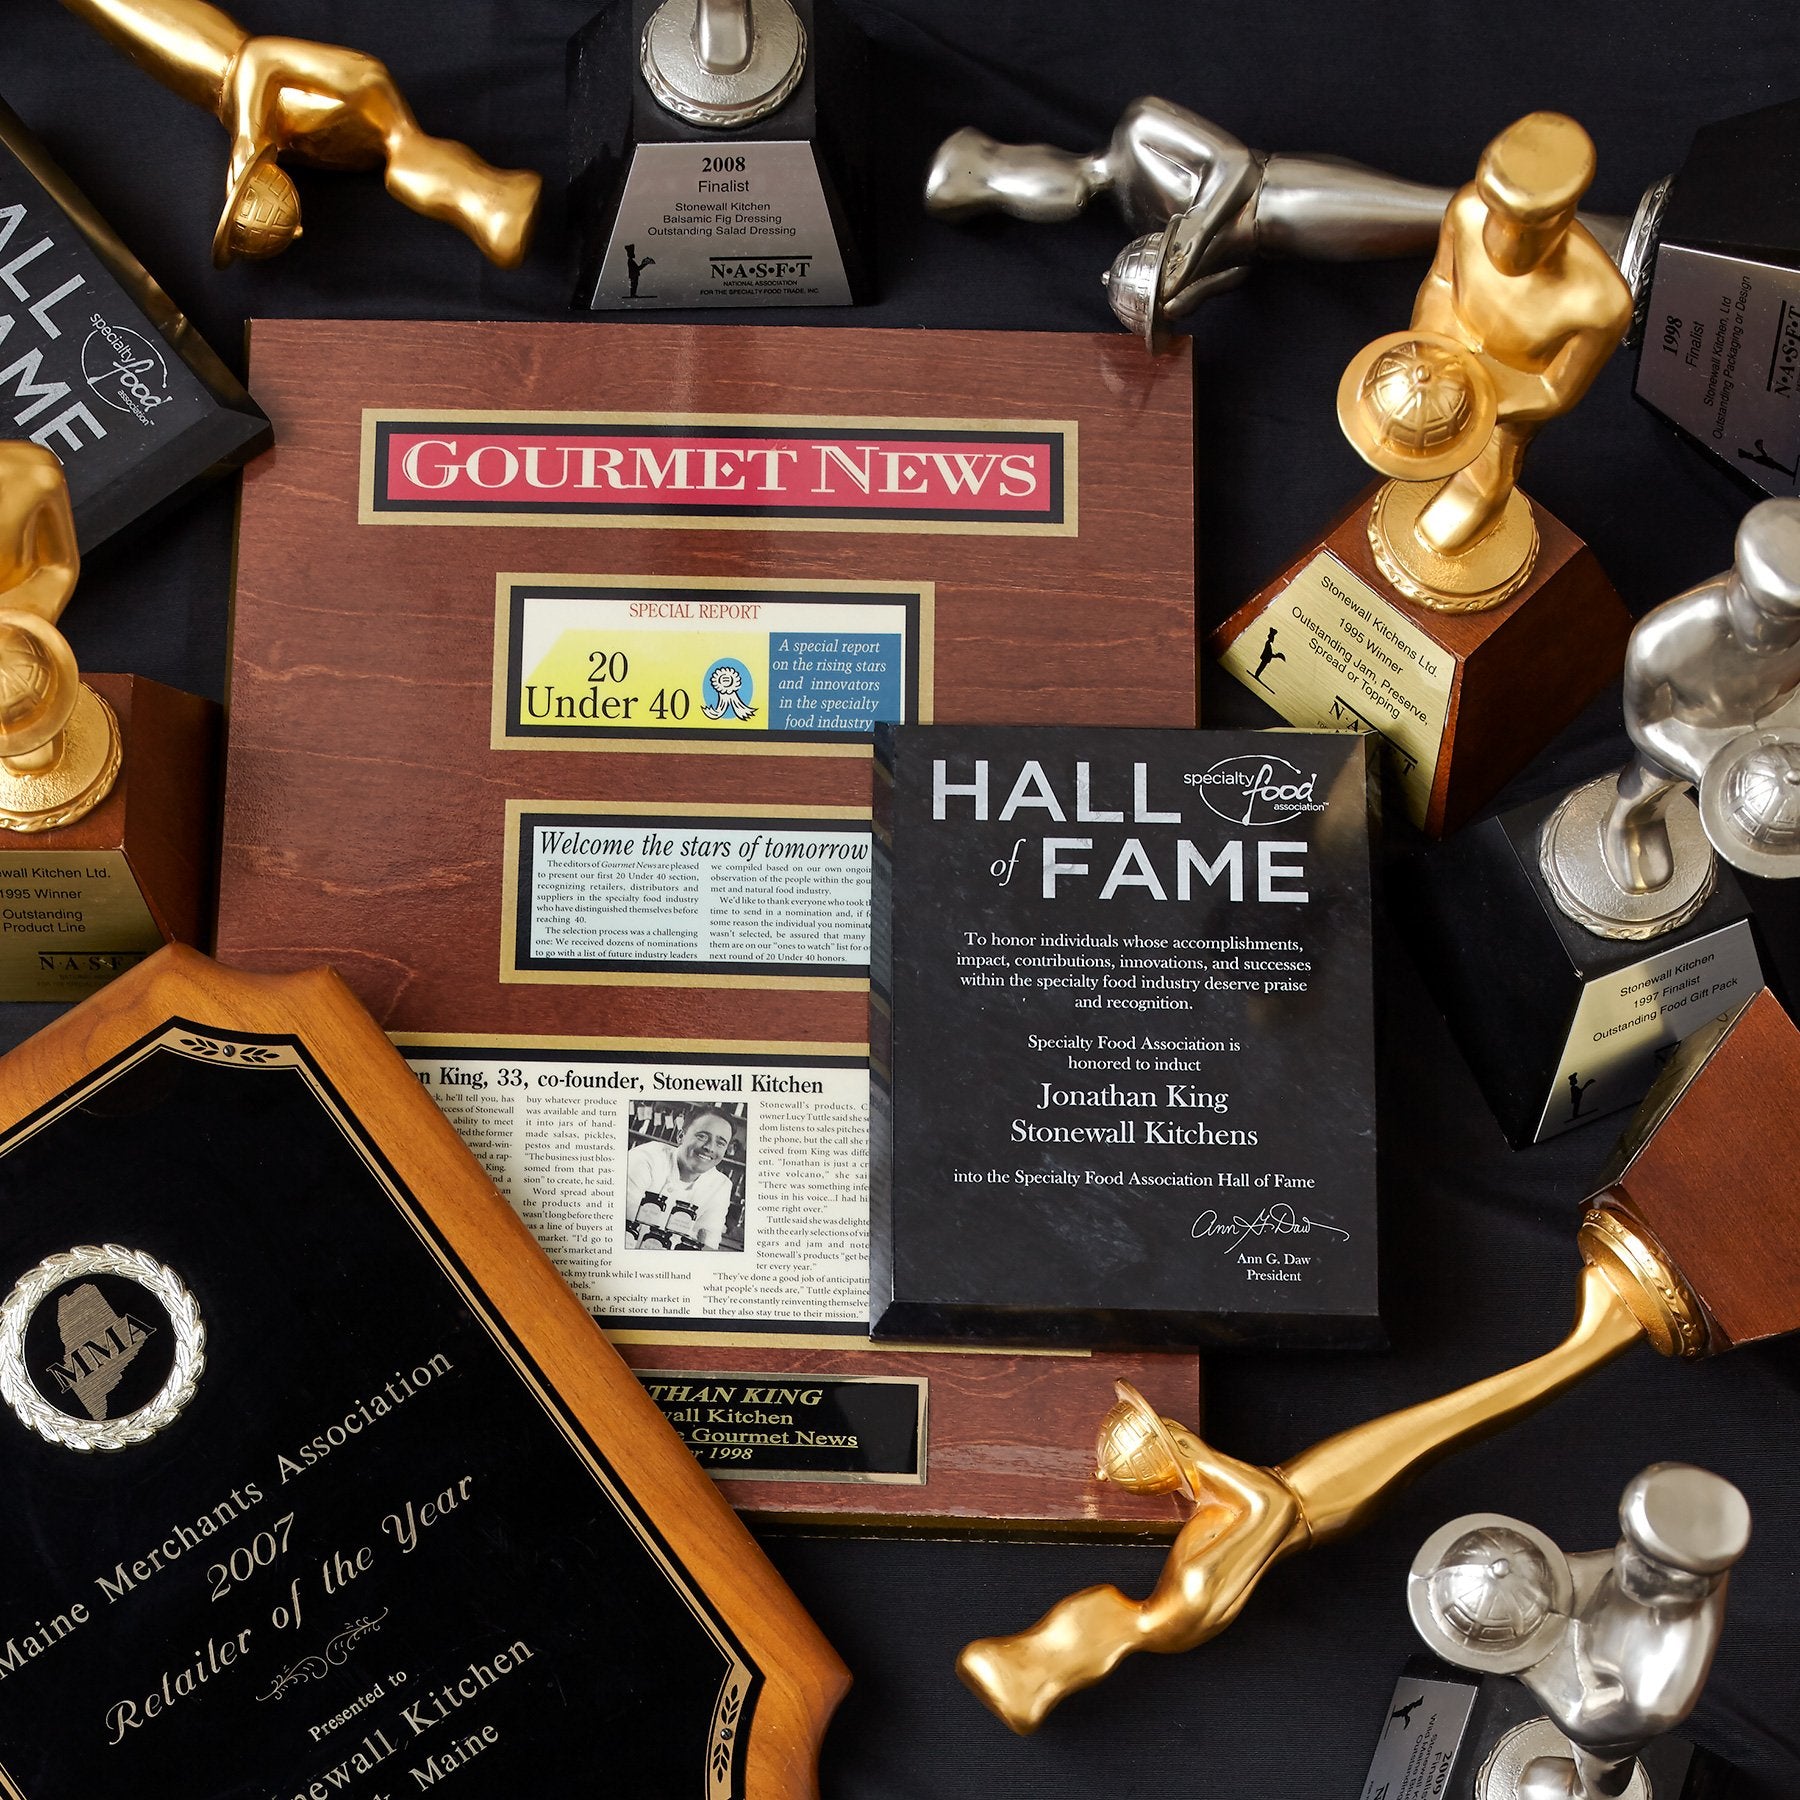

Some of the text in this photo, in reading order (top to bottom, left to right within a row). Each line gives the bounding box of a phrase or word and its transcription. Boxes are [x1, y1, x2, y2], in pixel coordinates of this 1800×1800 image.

[702, 156, 746, 173] 2008
[698, 180, 749, 193] Finalist
[675, 202, 771, 212] Stonewall Kitchen
[663, 214, 782, 225] Balsamic Fig Dressing
[647, 226, 796, 237] Outstanding Salad Dressing
[90, 313, 136, 363] specialty
[1662, 315, 1683, 357] 1998
[1685, 321, 1705, 368] Finalist
[1712, 275, 1752, 440] Outstanding Packaging or Design
[87, 358, 173, 412] food
[1703, 357, 1722, 407] Stonewall
[629, 602, 762, 620] SPECIAL REPORT
[1321, 575, 1439, 678] Stonewall Kitchens Ltd.
[778, 639, 880, 656] A special report
[1339, 618, 1404, 675] 1995 Winner
[588, 651, 629, 683] 20
[772, 658, 886, 674] on the rising stars
[1291, 606, 1430, 727] Outstanding Jam, Preserve,
[778, 677, 880, 691] and innovators
[1308, 638, 1401, 720] Spread or Topping
[525, 685, 690, 721] Under 40
[779, 696, 879, 712] in the specialty
[784, 714, 874, 732] food industry
[1183, 771, 1254, 787] specialty
[933, 759, 1181, 823] HALL
[1241, 764, 1317, 825] food
[541, 831, 869, 862] Welcome the stars of tomorrow
[32, 868, 111, 878] Kitchen Ltd.
[990, 837, 1309, 903] of FAME
[35, 889, 82, 899] Winner
[537, 883, 586, 892] recognizing
[630, 883, 679, 892] distributors
[683, 884, 699, 892] and
[3, 909, 83, 922] Outstanding
[3, 922, 86, 933] Product Line
[964, 932, 1304, 952] To honor individuals whose accomplishments,
[956, 954, 1312, 972] impact, contributions, innovations, and successes
[960, 973, 1308, 994] within the specialty food industry deserve praise
[1620, 952, 1715, 998] Stonewall Kitchen
[1634, 975, 1701, 1009] 1997 Finalist
[1074, 995, 1194, 1012] and recognition.
[1592, 976, 1738, 1043] Outstanding Food Gift Pack
[1028, 1035, 1241, 1051] Specialty Food Association is
[1068, 1056, 1202, 1072] honored to induct
[439, 1066, 823, 1093] King, 33, co-founder, Stonewall Kitchen
[1037, 1083, 1229, 1114] Jonathan King
[1010, 1119, 1259, 1146] Stonewall Kitchens
[555, 1142, 571, 1150] and
[953, 1169, 1315, 1189] into the Specialty Food Association Hall of Fame
[1237, 1253, 1311, 1266] Ann G. Daw
[1246, 1269, 1302, 1282] President
[46, 1313, 157, 1394] MMA
[741, 1388, 823, 1406] KING
[707, 1409, 794, 1425] Kitchen
[692, 1428, 858, 1447] Gourmet News
[709, 1447, 753, 1460] 1998
[0, 1350, 455, 1680] Maine Merchants Association
[206, 1511, 295, 1602] 2007
[105, 1474, 474, 1746] Retailer of the Year
[399, 1637, 534, 1738] Kitchen
[308, 1671, 407, 1742] Presented to
[408, 1725, 499, 1792] Maine
[1433, 1751, 1452, 1795] 2009
